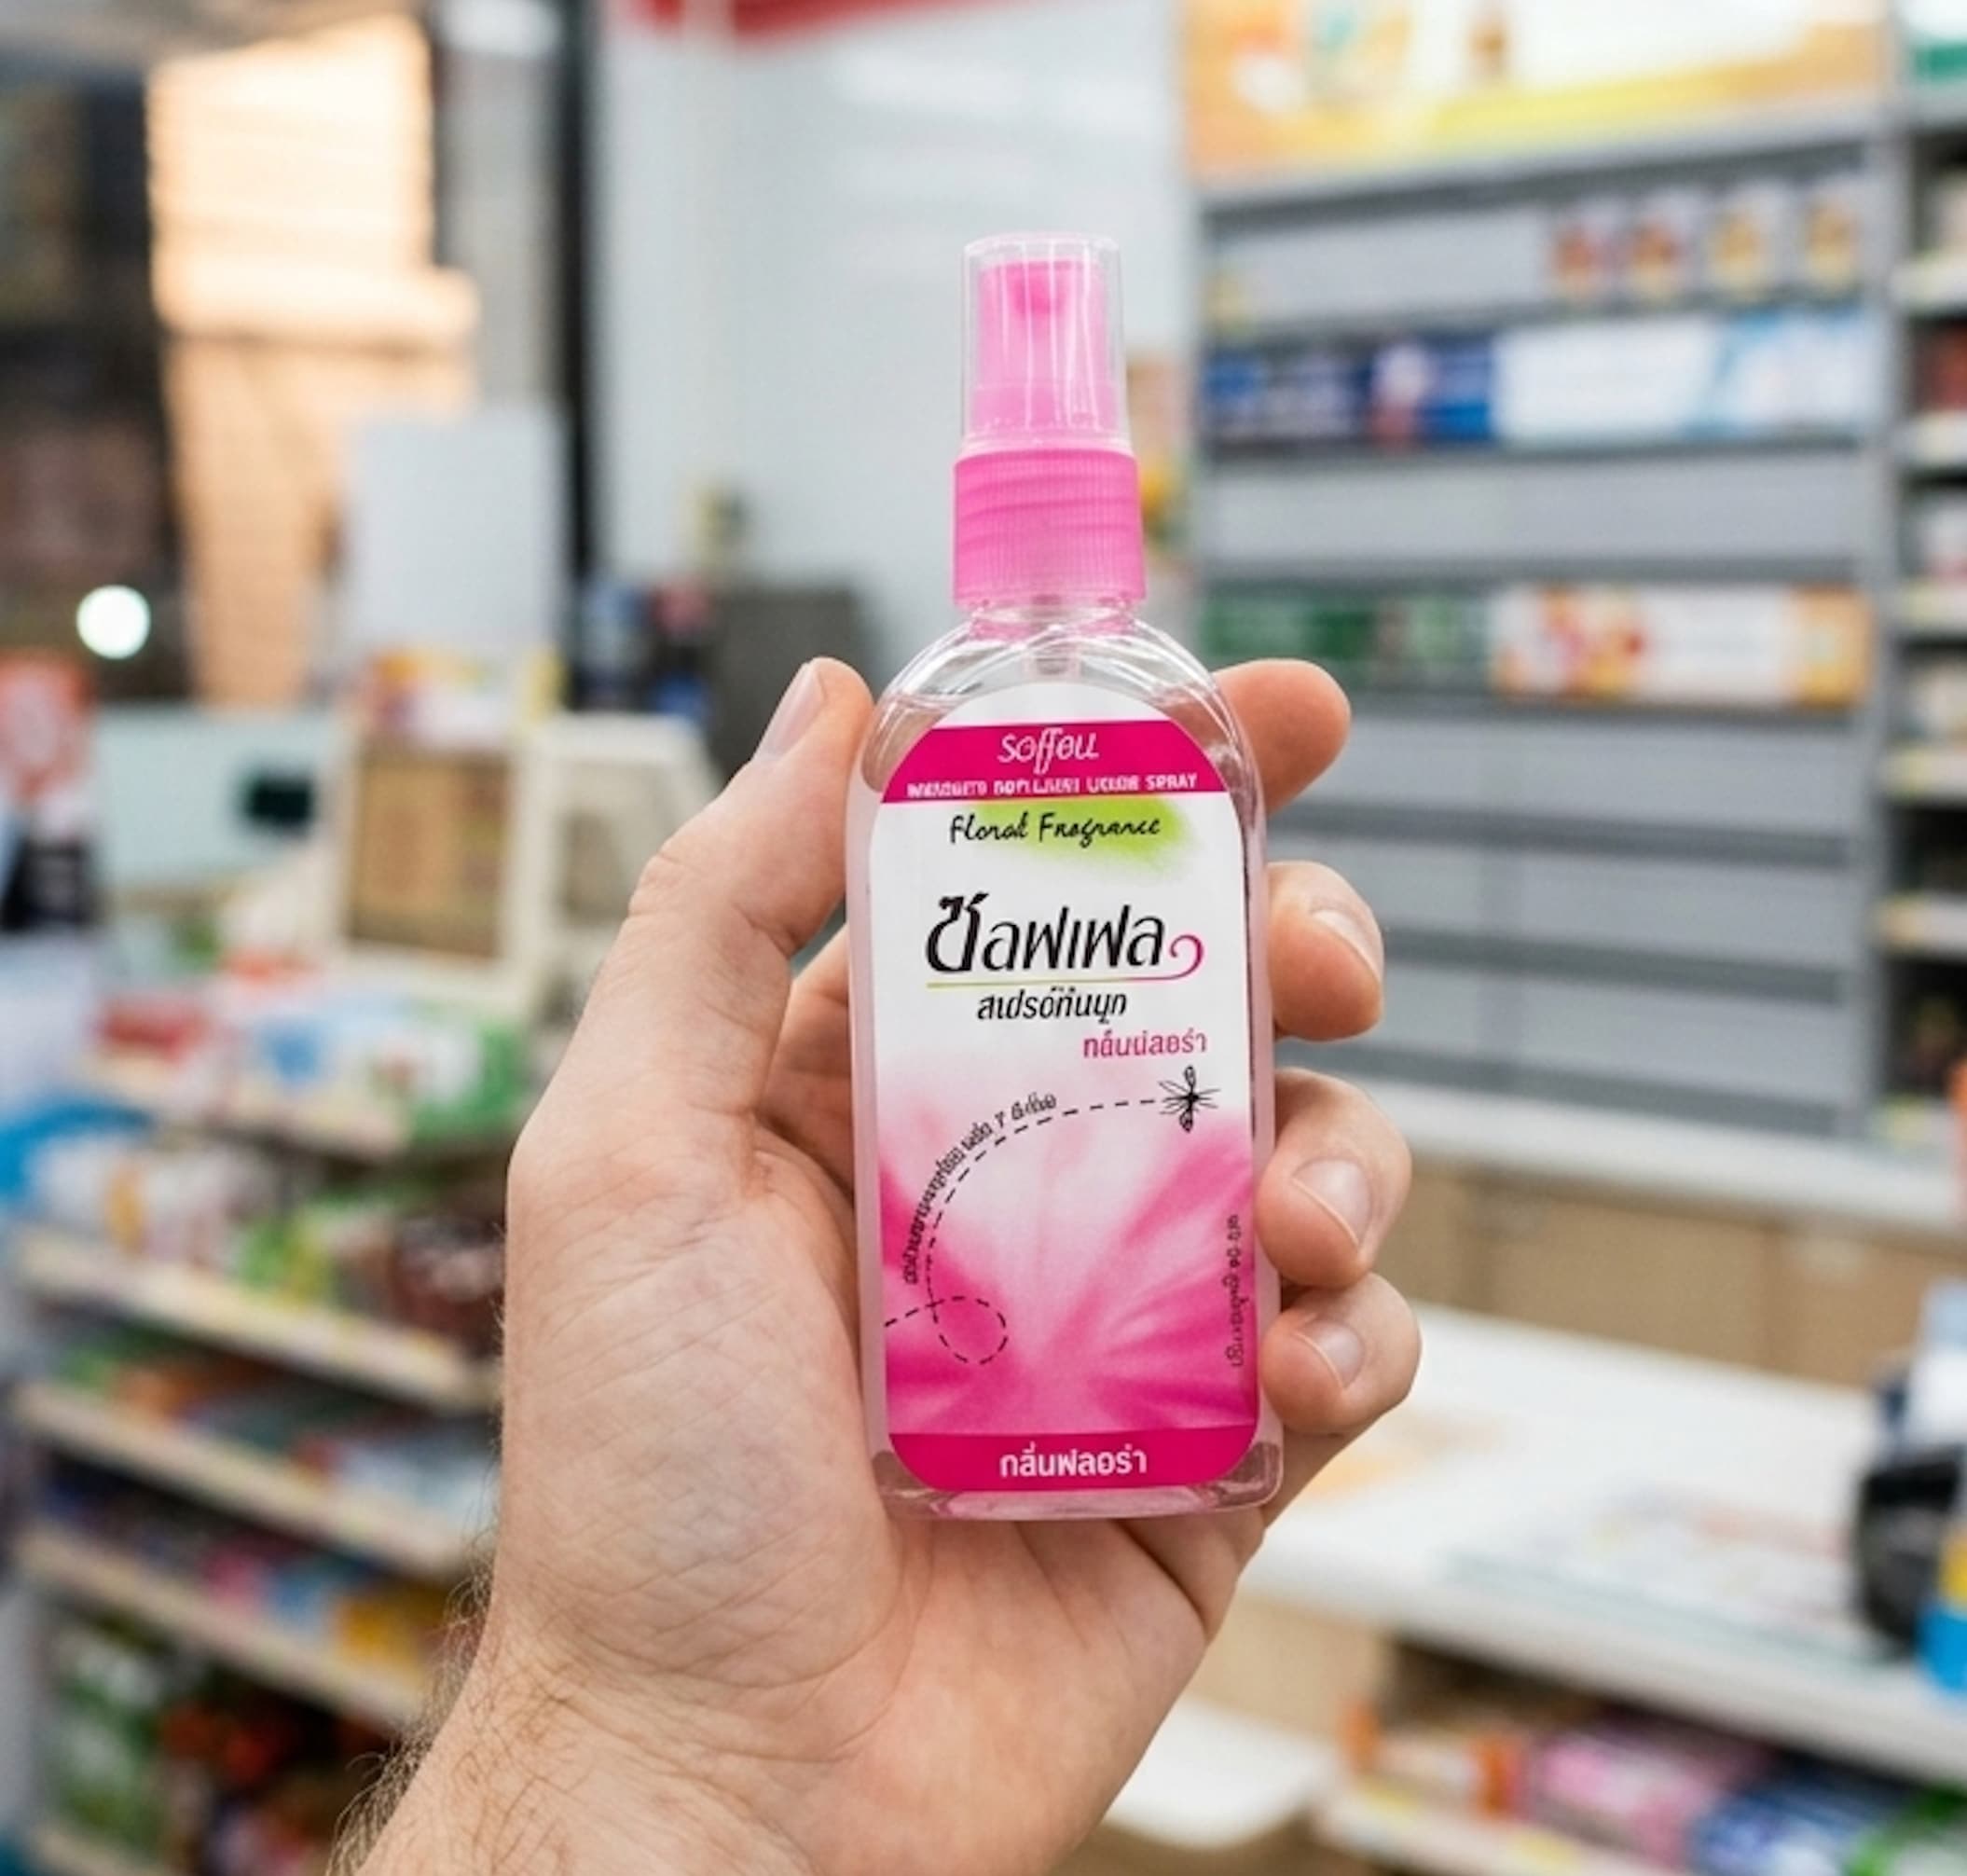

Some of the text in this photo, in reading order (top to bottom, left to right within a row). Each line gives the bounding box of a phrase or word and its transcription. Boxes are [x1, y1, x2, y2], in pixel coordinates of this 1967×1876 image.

[1146, 772, 1198, 791] SPRAY
[999, 1441, 1148, 1478] กลิ่นฟลอร่า
